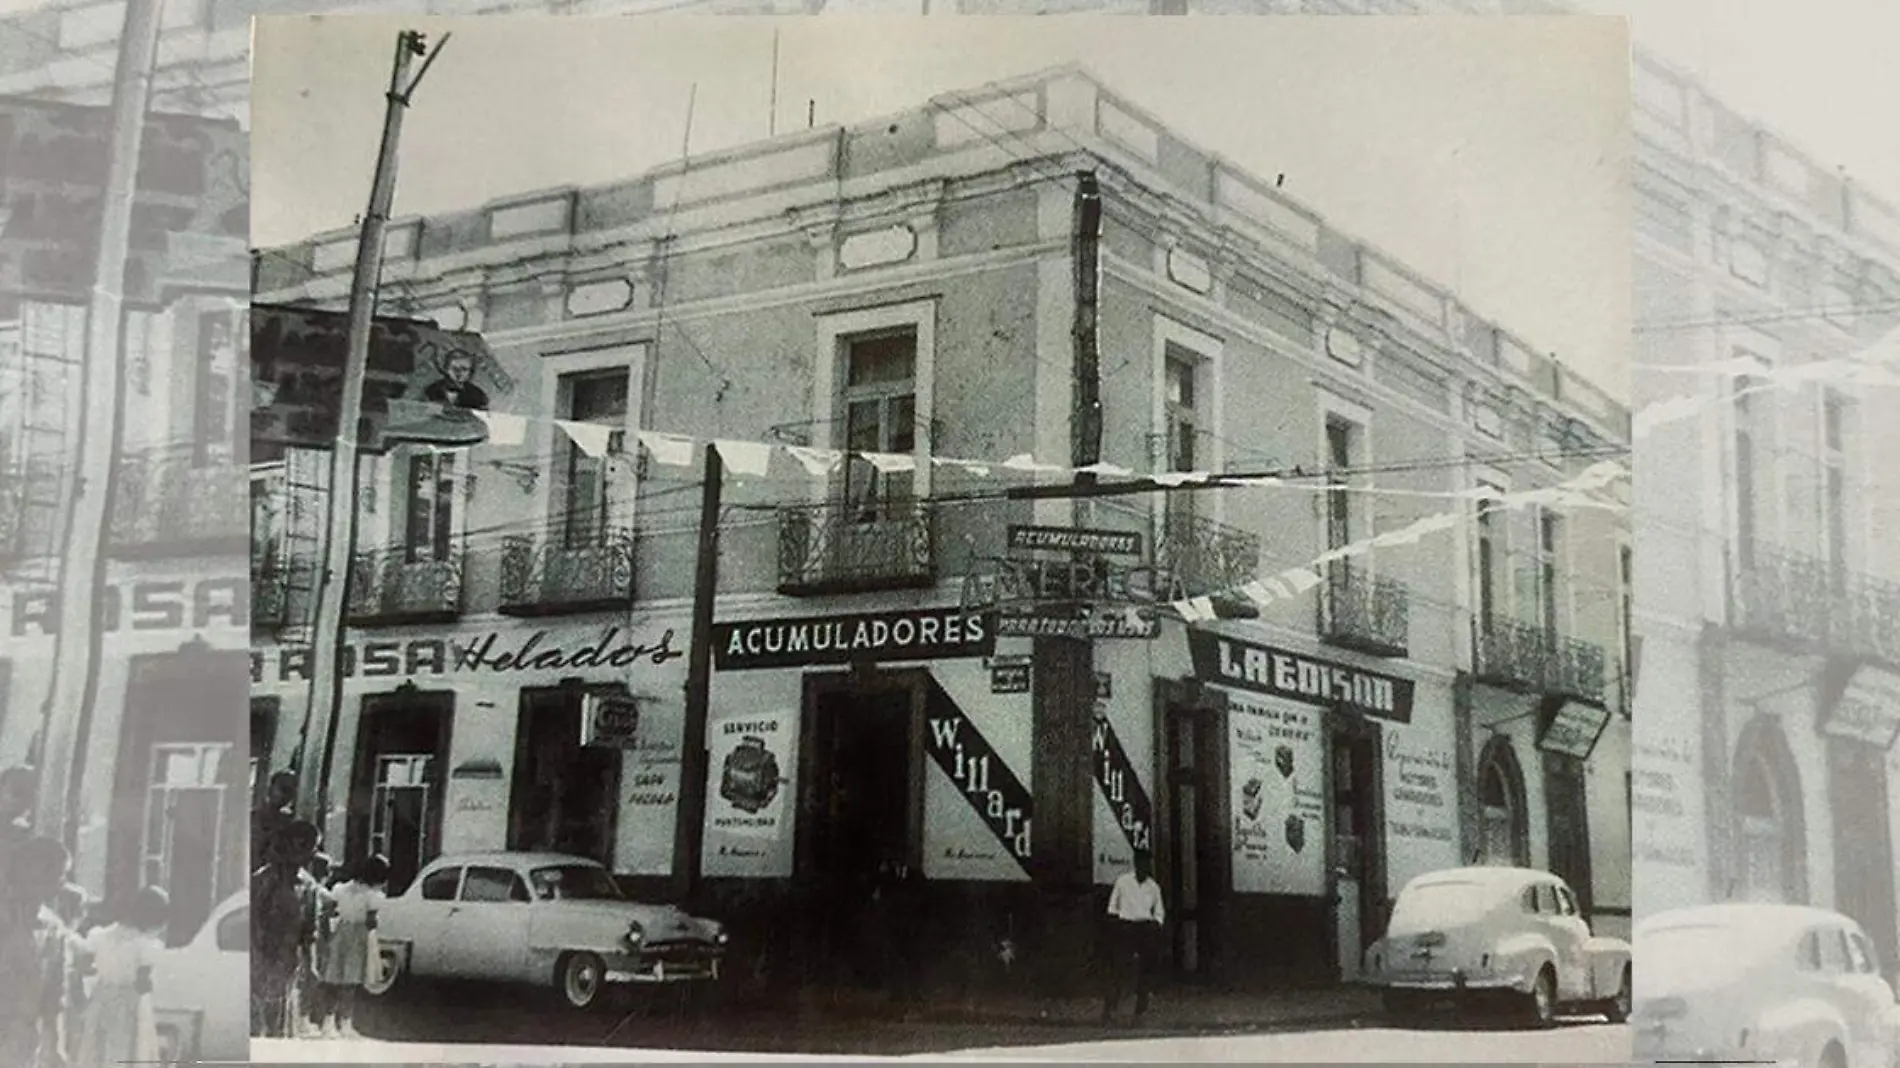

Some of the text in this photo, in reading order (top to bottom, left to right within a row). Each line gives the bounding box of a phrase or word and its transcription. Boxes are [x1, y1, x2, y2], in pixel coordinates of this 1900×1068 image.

[453, 627, 683, 673] Helados
[727, 614, 985, 655] ACUMULADORES
[1218, 639, 1395, 712] LA EDISON
[930, 718, 1033, 858] Willard
